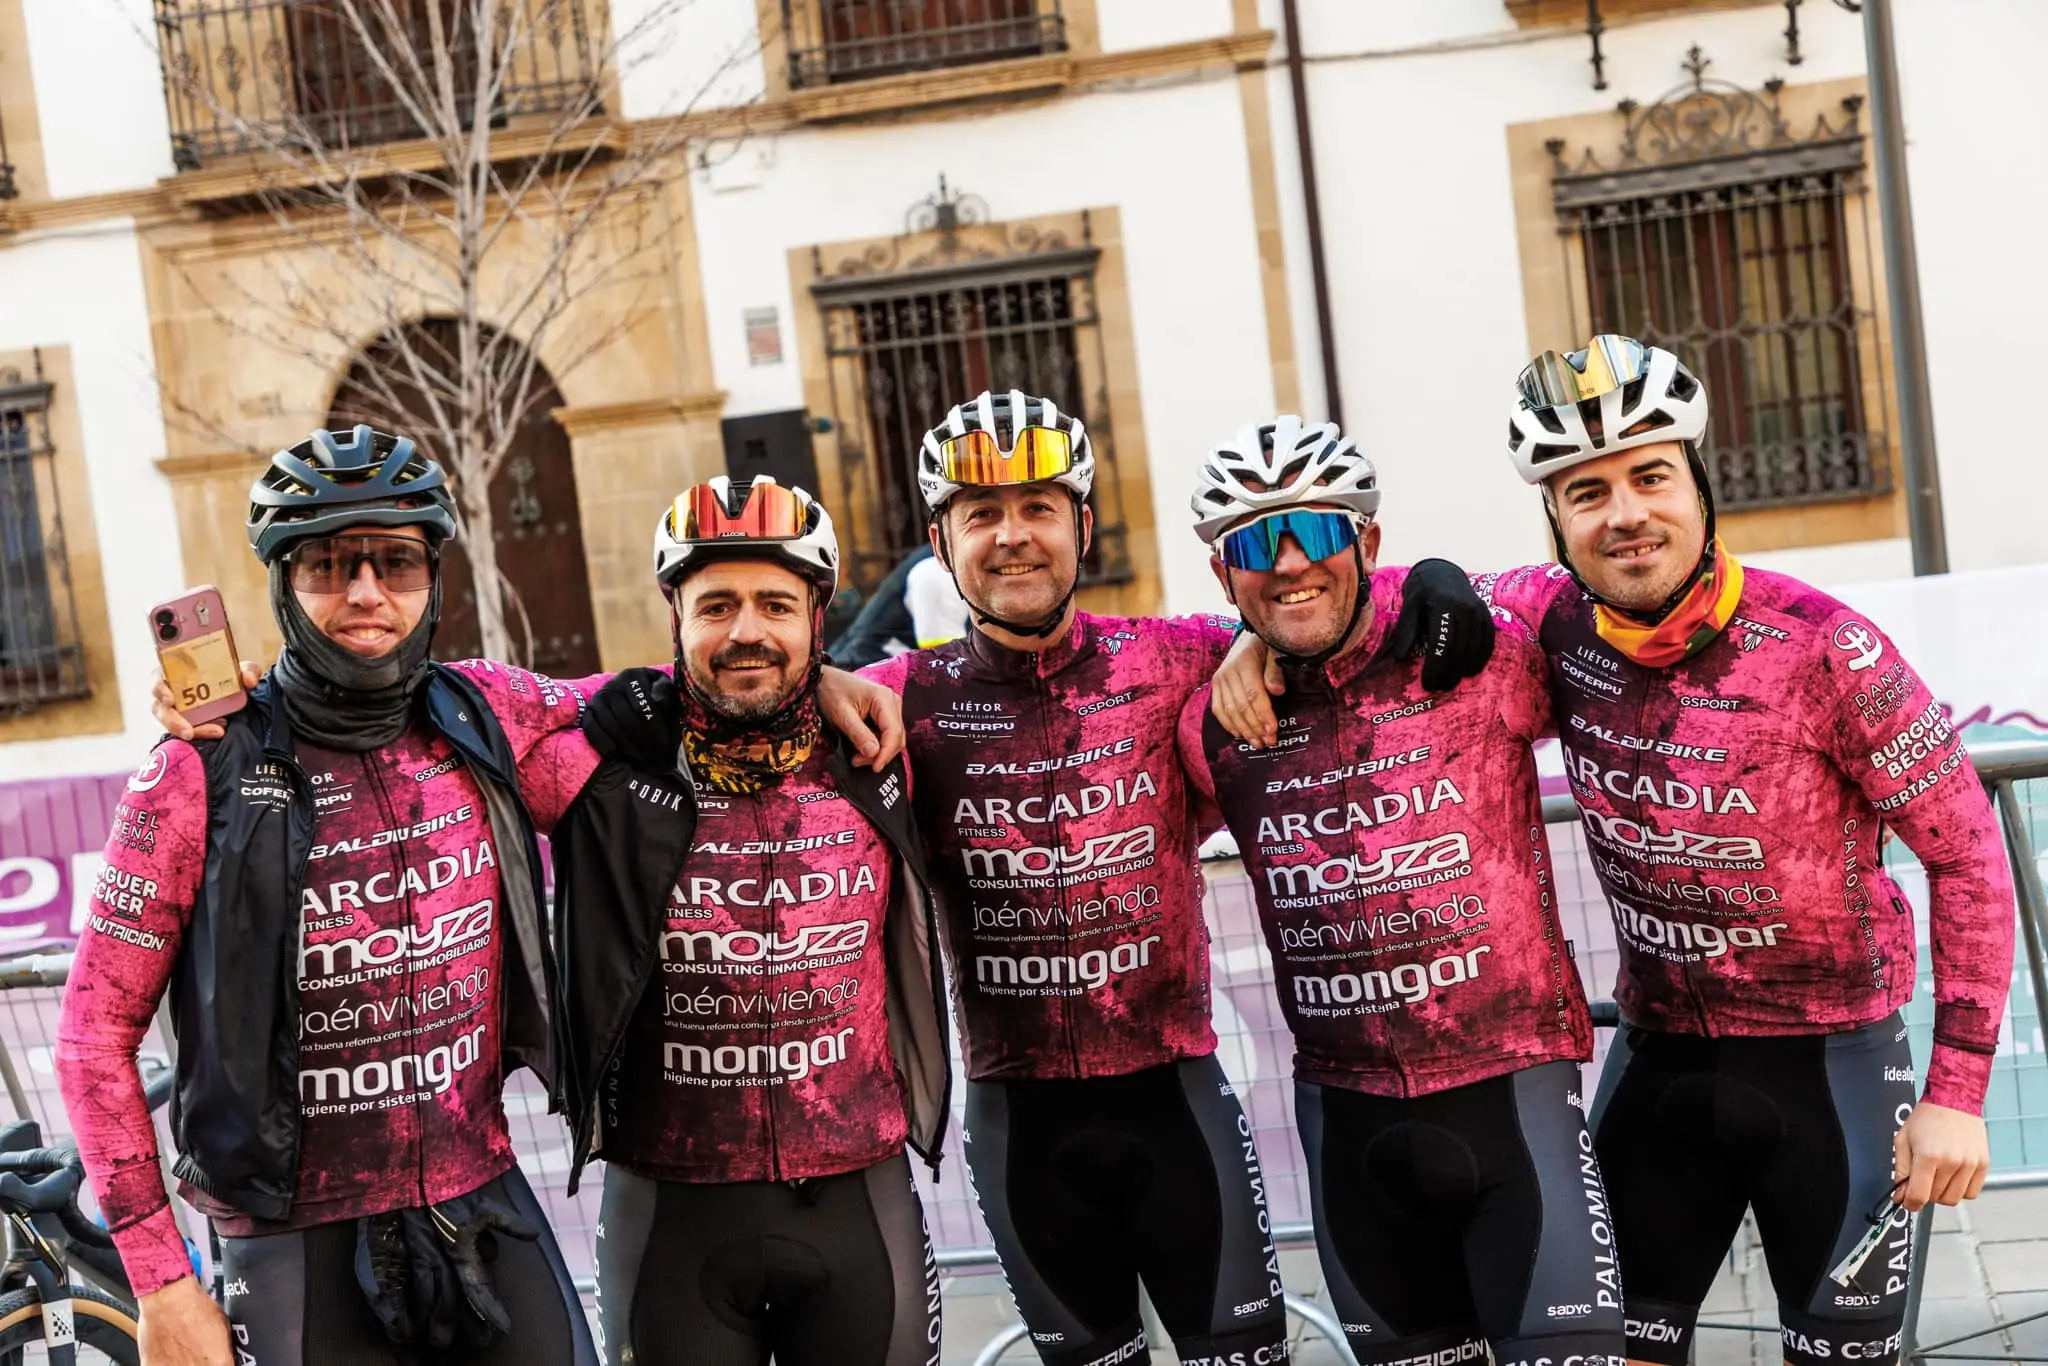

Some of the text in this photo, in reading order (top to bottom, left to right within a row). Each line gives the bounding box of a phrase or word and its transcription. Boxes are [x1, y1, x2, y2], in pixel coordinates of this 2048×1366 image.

[1434, 611, 1451, 656] KIPSTA
[1734, 617, 1790, 641] TREK
[1577, 645, 1619, 672] LIÉTOR
[182, 683, 210, 706] 50
[1562, 661, 1622, 695] COFERPU
[630, 680, 653, 721] KIPSTA
[952, 700, 1002, 712] LIÉTOR
[1078, 691, 1133, 717] GSPORT
[1372, 699, 1434, 724] GSPORT
[1680, 696, 1739, 711] GSPORT
[938, 720, 1015, 731] COFERPU
[1870, 699, 1942, 769] BURGUER
[1887, 717, 1952, 779] BECKER
[415, 758, 458, 782] GSPORT
[1564, 744, 1759, 815] ARCADIA
[629, 779, 683, 811] GOBIK
[797, 790, 840, 803] GSPO
[953, 771, 1157, 825] ARCADIA
[1257, 778, 1462, 843] ARCADIA
[115, 804, 159, 829] NIEL
[958, 828, 1006, 839] FITNESS
[960, 824, 1156, 877] moyza
[1261, 843, 1304, 855] FITNESS
[1265, 832, 1471, 896] moyza
[1649, 854, 1766, 871] INMOBILIARIO
[1844, 819, 1858, 887] CANO
[302, 840, 496, 917] ARCADIA
[969, 855, 1155, 890] CONSULTING INMOBILIARIO
[1273, 864, 1472, 909] CONSULTING INMOBILIARIO
[303, 914, 354, 933] ITNESS
[666, 908, 713, 919] TNESS
[973, 883, 1161, 931] jaénvivienda
[1278, 893, 1487, 952] jaénvivienda
[1724, 910, 1749, 919] buen
[1750, 907, 1784, 917] estudio
[299, 899, 494, 978] moyza
[659, 919, 870, 962] moyza
[1011, 934, 1041, 943] reforma
[1079, 925, 1102, 937] desde
[1103, 923, 1114, 932] un
[1115, 920, 1135, 931] buen
[1317, 951, 1347, 961] reforma
[1385, 939, 1414, 952] desde
[1415, 937, 1429, 947] un
[1430, 931, 1455, 945] buen
[1456, 921, 1489, 937] estudio
[1611, 895, 1788, 958] mongar
[298, 934, 490, 991] CONSULTING INMOBILIARIO
[662, 949, 862, 976] CONSULTING INMOBILIARIO
[976, 935, 1160, 990] mongar
[1639, 943, 1657, 956] por
[979, 984, 1017, 997] higiene
[1019, 986, 1038, 998] por
[1293, 945, 1492, 1005] mongar
[298, 966, 489, 1040] jaénvivienda
[663, 977, 858, 1017] jaénvivienda
[1298, 1005, 1330, 1018] higiene
[1332, 1007, 1351, 1019] por
[315, 1040, 344, 1051] buena
[345, 1035, 382, 1048] reforma
[424, 1018, 446, 1032] desde
[447, 1015, 457, 1024] un
[680, 1021, 705, 1031] buena
[706, 1021, 739, 1030] reforma
[781, 1017, 805, 1027] desde
[806, 1016, 816, 1024] un
[298, 1024, 486, 1101] mongar
[663, 1027, 854, 1081] mongar
[664, 1071, 708, 1087] higiene
[711, 1076, 733, 1089] por
[302, 1104, 347, 1118] igiene
[350, 1101, 375, 1114] por
[1579, 1129, 1618, 1309] PALOMINO
